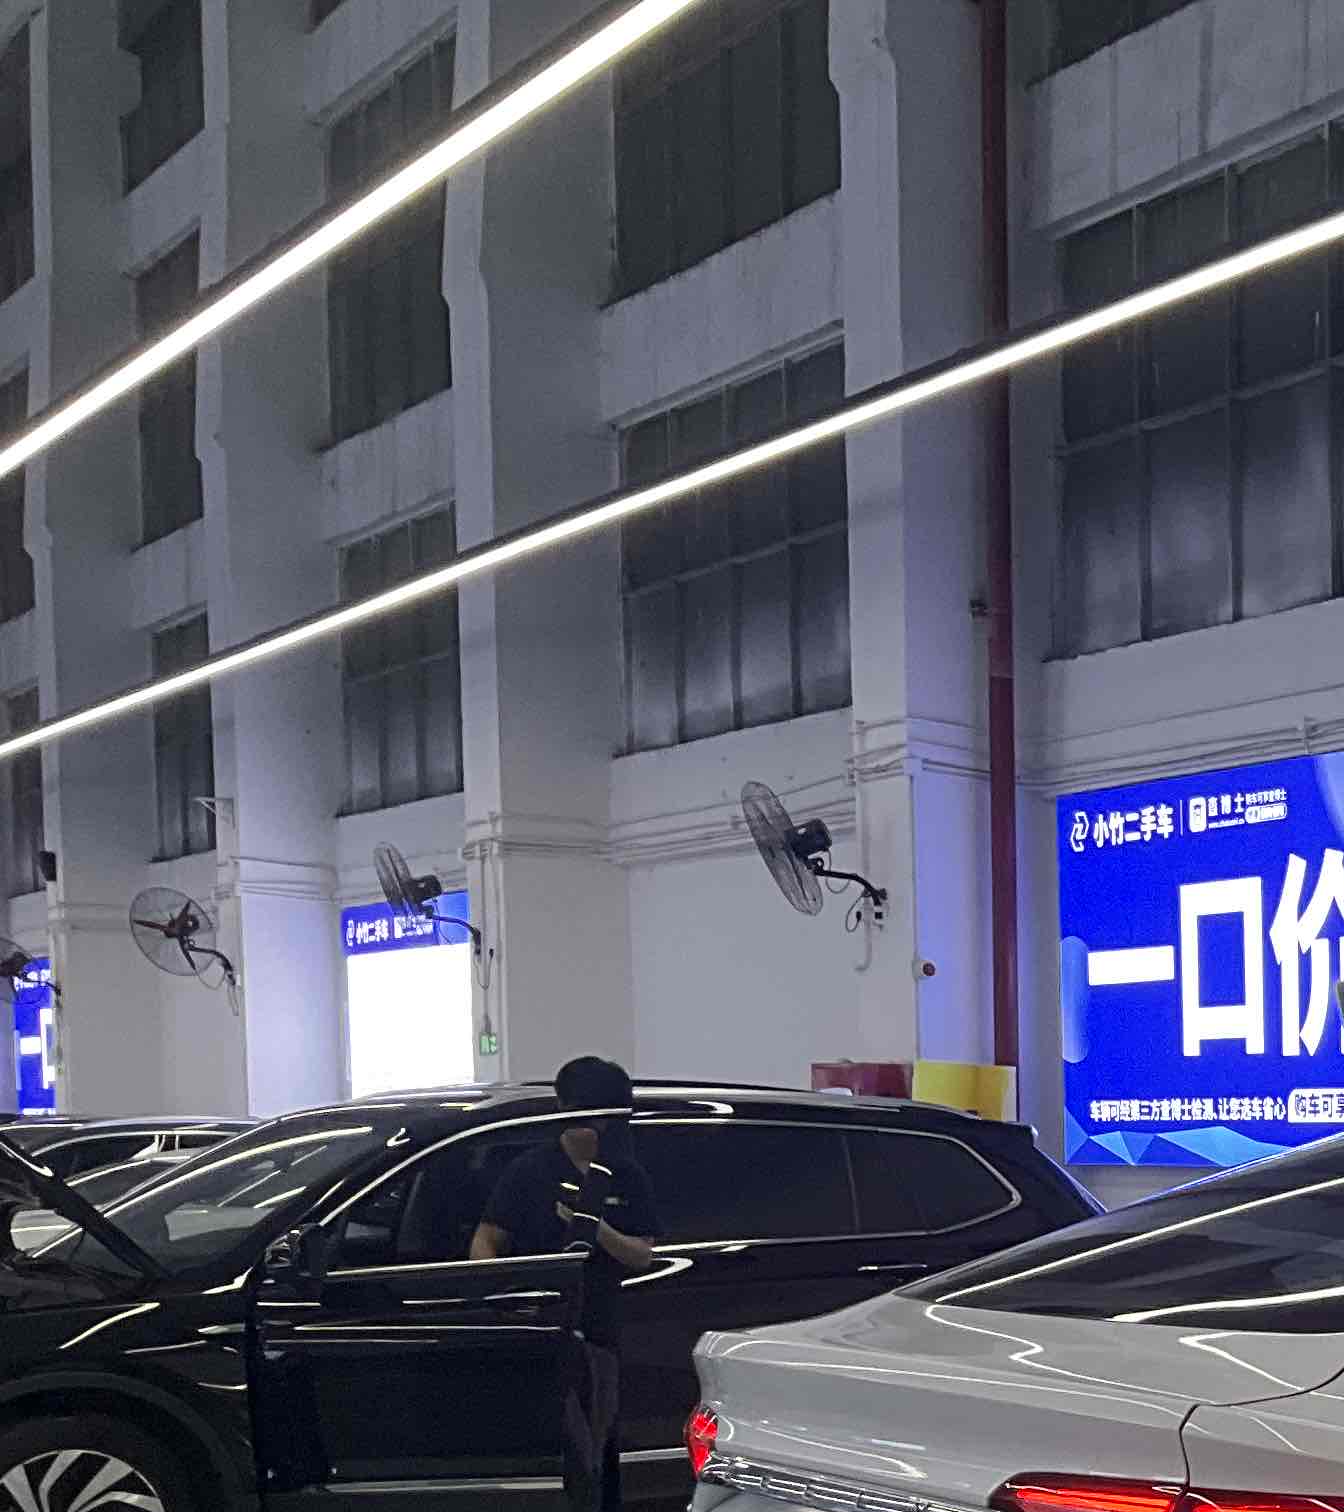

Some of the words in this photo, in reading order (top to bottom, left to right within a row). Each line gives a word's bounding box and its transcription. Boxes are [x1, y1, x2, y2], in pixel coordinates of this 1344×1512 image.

[1093, 803, 1174, 848] 小竹二手车
